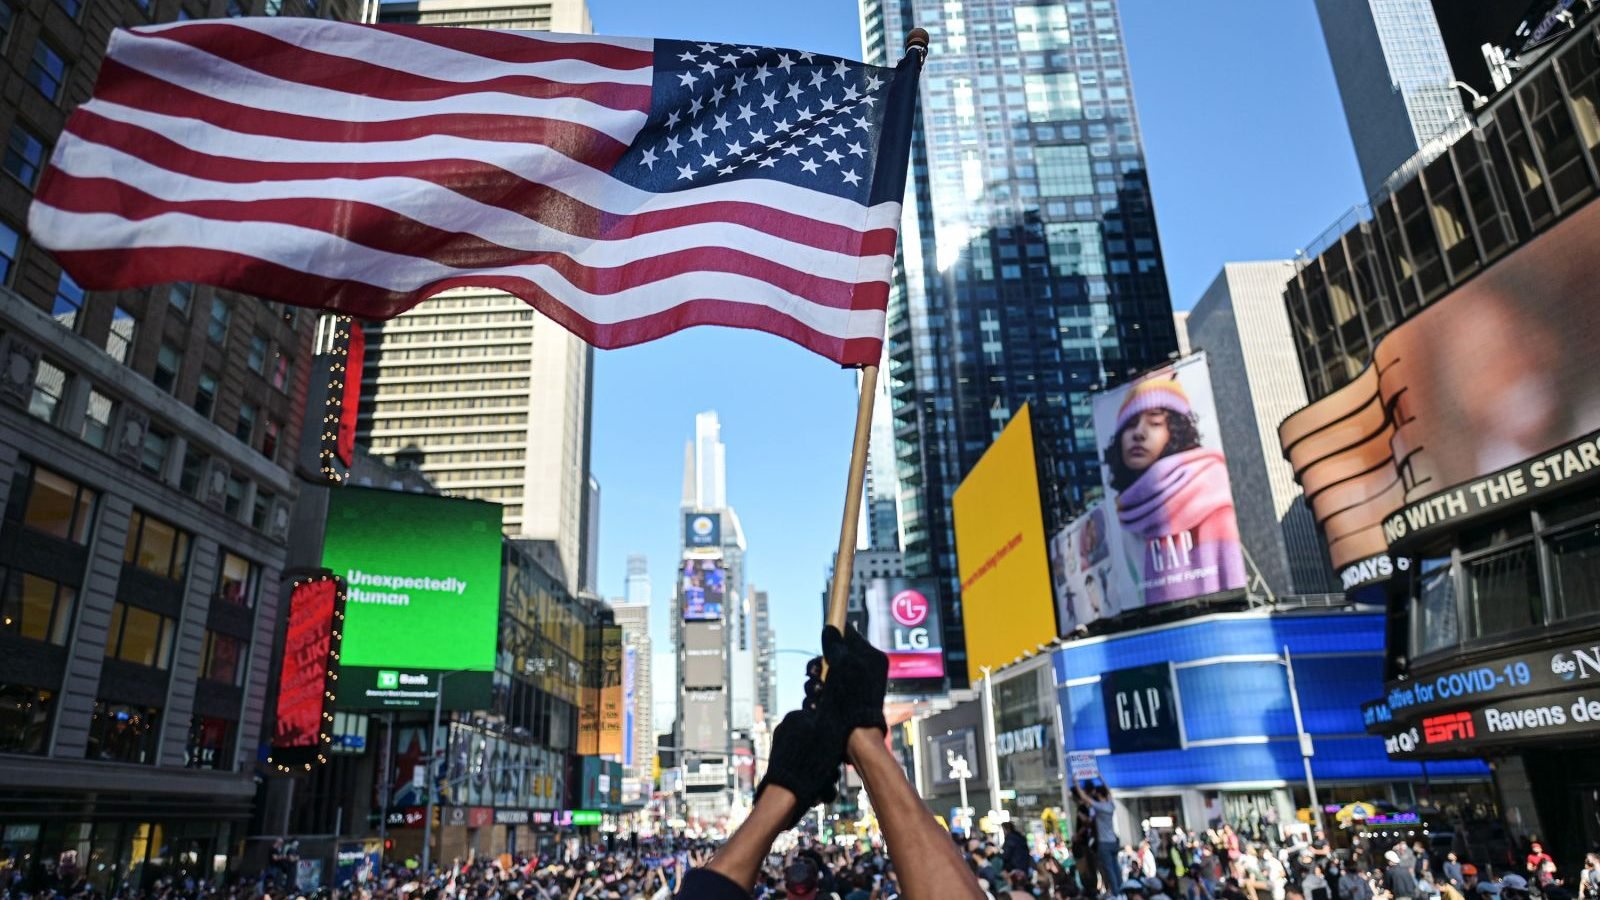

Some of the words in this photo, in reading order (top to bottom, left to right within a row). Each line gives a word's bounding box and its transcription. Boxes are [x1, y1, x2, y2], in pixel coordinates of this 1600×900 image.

[1405, 490, 1468, 531] WITH
[1470, 468, 1528, 508] THE
[1530, 436, 1600, 488] STAR
[1150, 530, 1193, 572] GAP
[346, 586, 410, 606] Human
[347, 569, 467, 595] Unexpectedly
[894, 627, 929, 650] LG
[399, 673, 429, 685] Bank
[1414, 682, 1434, 704] for
[1437, 661, 1531, 699] COVID-19
[1551, 656, 1576, 673] abc
[1116, 687, 1160, 731] GAP
[1422, 711, 1476, 744] ESPN
[1484, 705, 1567, 733] Ravens
[1571, 696, 1600, 723] de
